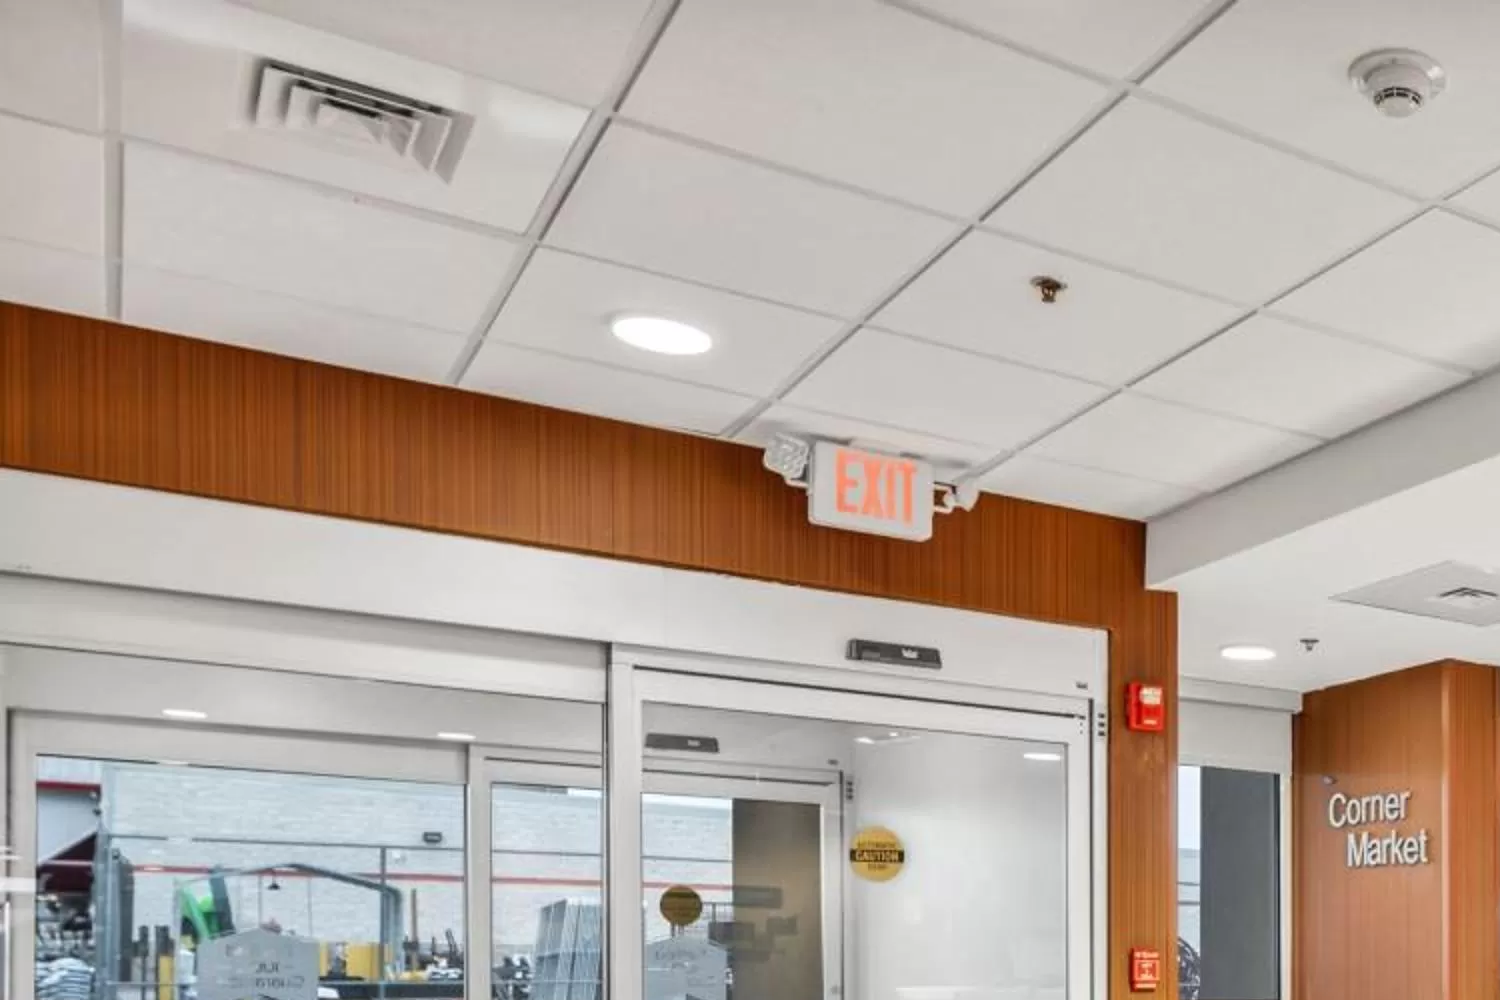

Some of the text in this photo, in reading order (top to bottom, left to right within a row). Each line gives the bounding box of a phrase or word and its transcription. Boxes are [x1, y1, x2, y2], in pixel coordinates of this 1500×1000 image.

[835, 448, 917, 527] EXIT
[1328, 791, 1411, 828] Corner
[855, 850, 899, 863] CAUTION
[1347, 829, 1428, 867] Market
